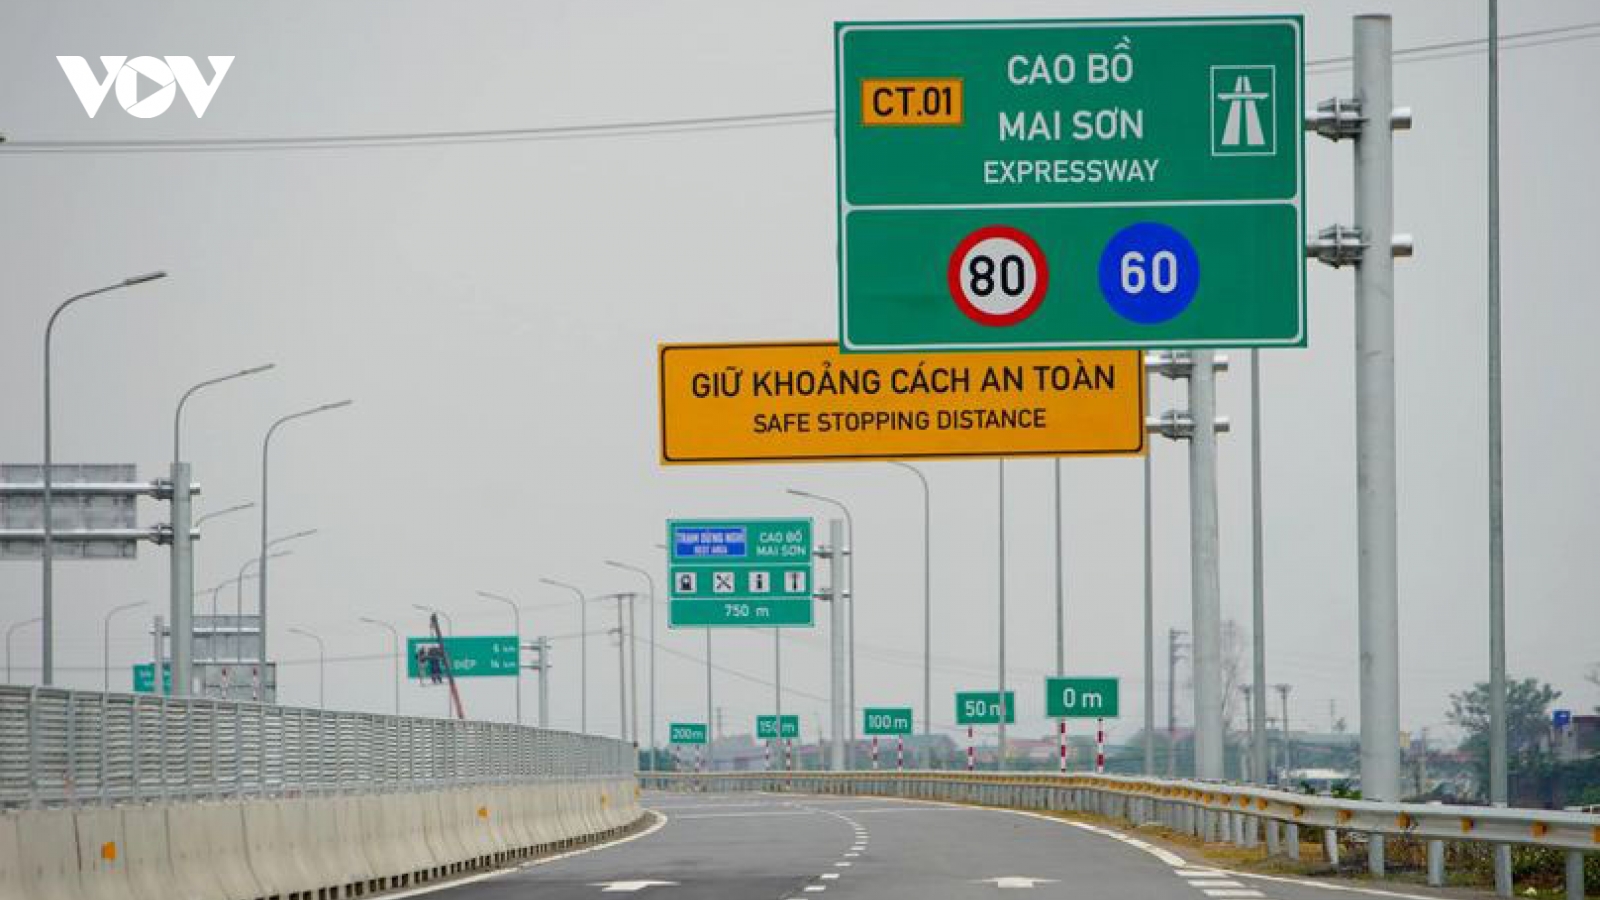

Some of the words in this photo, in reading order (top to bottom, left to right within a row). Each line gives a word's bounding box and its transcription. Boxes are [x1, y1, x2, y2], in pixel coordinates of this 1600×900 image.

[1007, 54, 1076, 86] CAO
[1088, 36, 1134, 84] BỒ
[872, 86, 952, 117] CT.01
[999, 110, 1061, 141] MAI
[1072, 107, 1143, 141] SƠN
[983, 159, 1159, 184] EXPRESSWAY
[969, 254, 1025, 298] 80
[1120, 250, 1177, 294] 60
[692, 365, 743, 399] GIỮ
[752, 361, 881, 397] KHOẢNG
[890, 361, 970, 395] CÁCH
[981, 365, 1023, 393] AN
[1033, 358, 1114, 391] TOÀN
[753, 413, 811, 434] SAFE
[817, 411, 930, 433] STOPPING
[937, 407, 1046, 430] DISTANCE
[760, 532, 782, 544] CAO
[756, 545, 778, 557] MAI
[725, 604, 749, 617] 750
[756, 606, 769, 617] m
[965, 700, 985, 717] 50
[1063, 687, 1076, 708] 0
[1082, 691, 1102, 708] m
[782, 722, 795, 733] m
[868, 714, 892, 729] 100
[894, 716, 908, 729] m
[672, 728, 691, 740] 200
[691, 731, 704, 740] m
